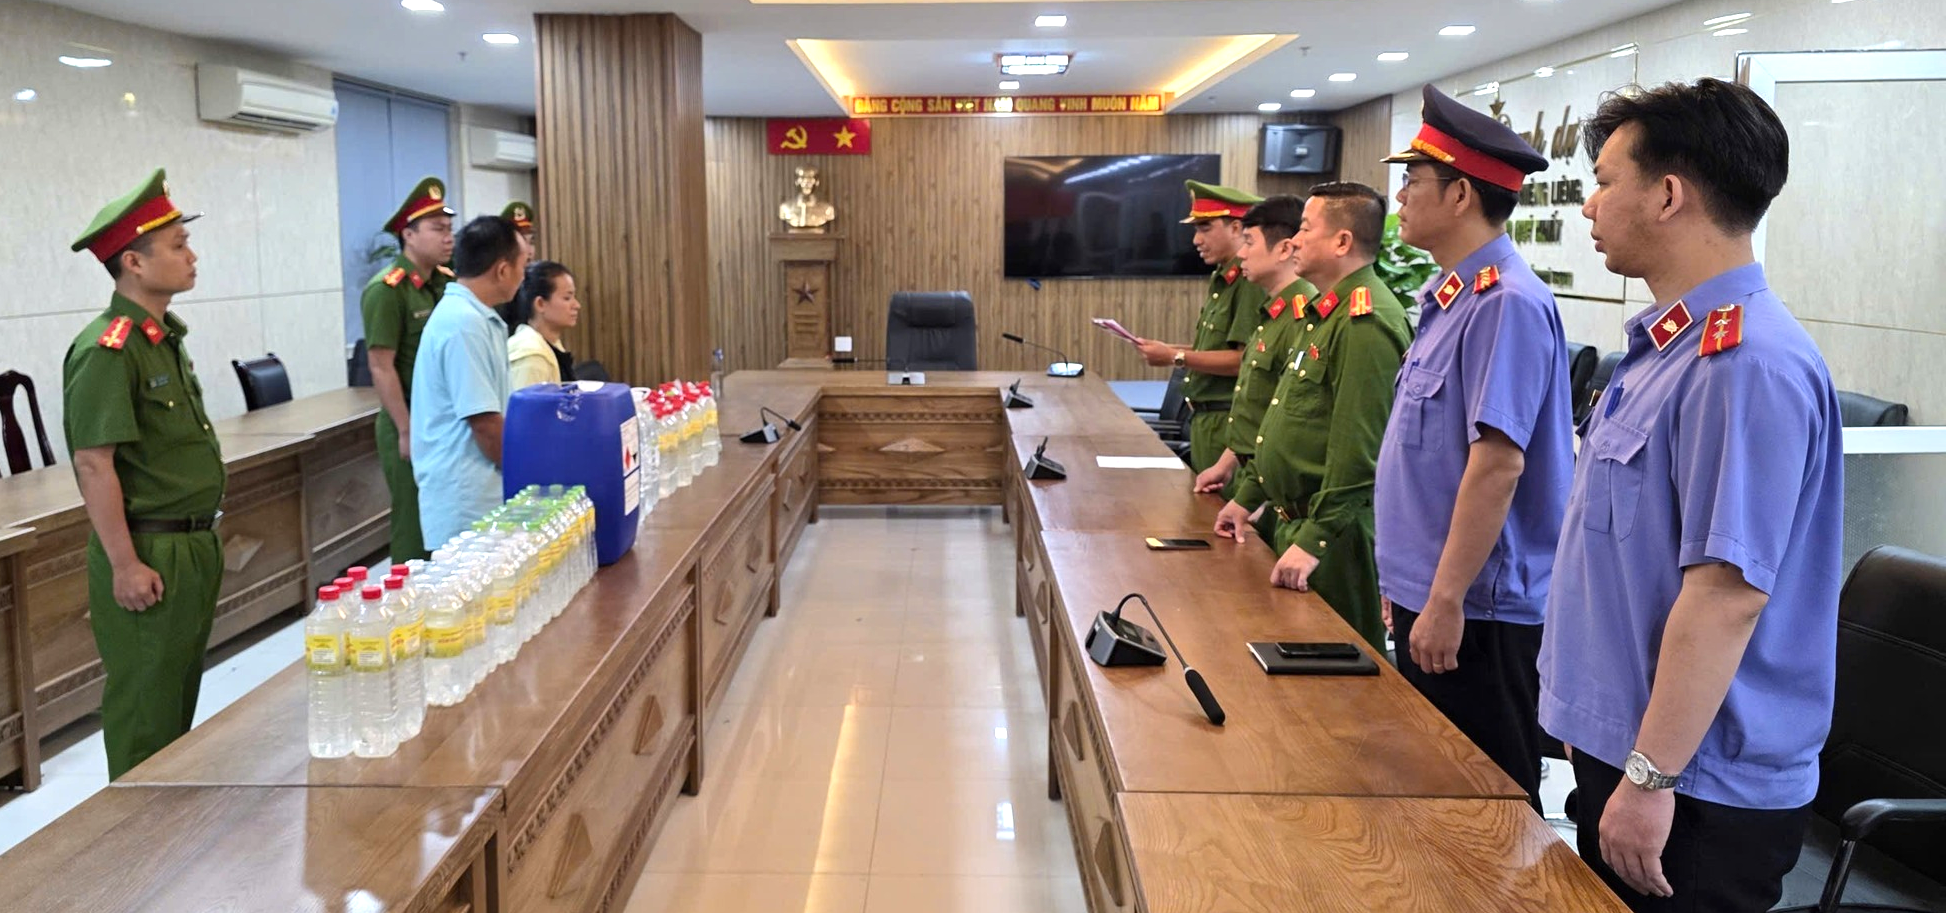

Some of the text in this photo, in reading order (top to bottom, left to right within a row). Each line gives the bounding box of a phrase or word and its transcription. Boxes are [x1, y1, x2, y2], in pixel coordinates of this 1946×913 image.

[891, 97, 924, 114] CỘNG
[927, 96, 951, 112] SẢN
[1015, 97, 1055, 112] QUANG
[1091, 95, 1127, 111] MUÔN
[1130, 95, 1160, 111] NĂM
